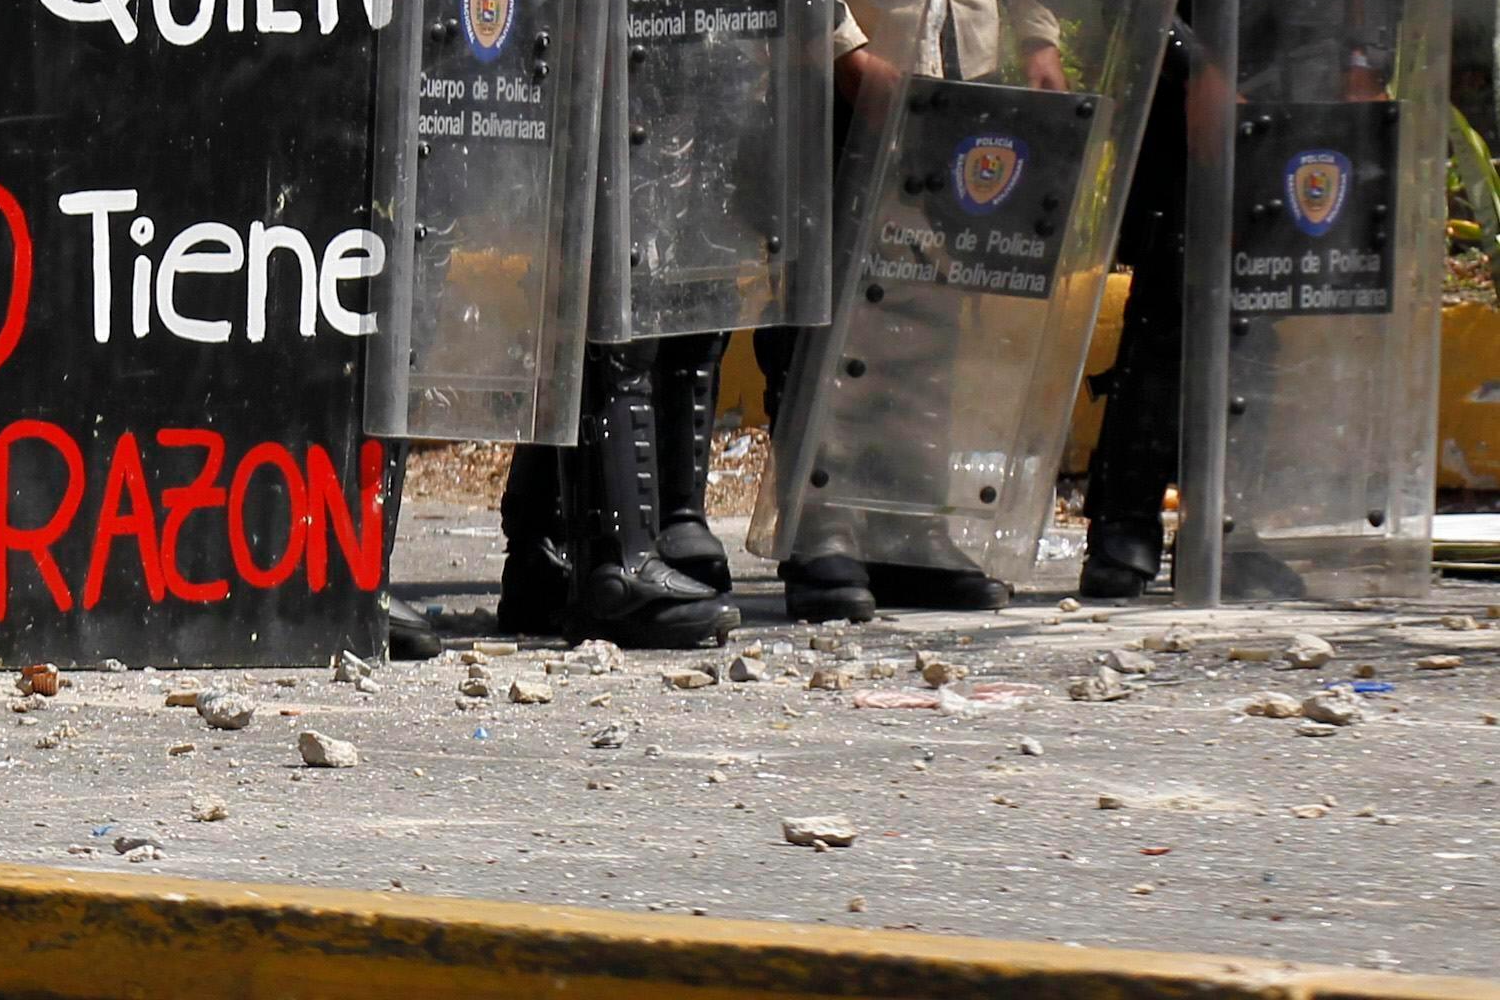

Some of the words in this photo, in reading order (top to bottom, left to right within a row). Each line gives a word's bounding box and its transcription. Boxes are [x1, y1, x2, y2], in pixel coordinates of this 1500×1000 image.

[694, 6, 778, 34] Bolivariana
[472, 74, 489, 100] de
[418, 109, 465, 136] acional
[471, 111, 546, 140] Bolivariana
[880, 220, 946, 252] Cuerpo
[955, 227, 978, 251] de
[58, 189, 386, 343] Tiene
[863, 251, 940, 282] Nacional
[947, 260, 1047, 293] Bolivariana
[1235, 252, 1293, 280] Cuerpo
[1301, 250, 1321, 273] de
